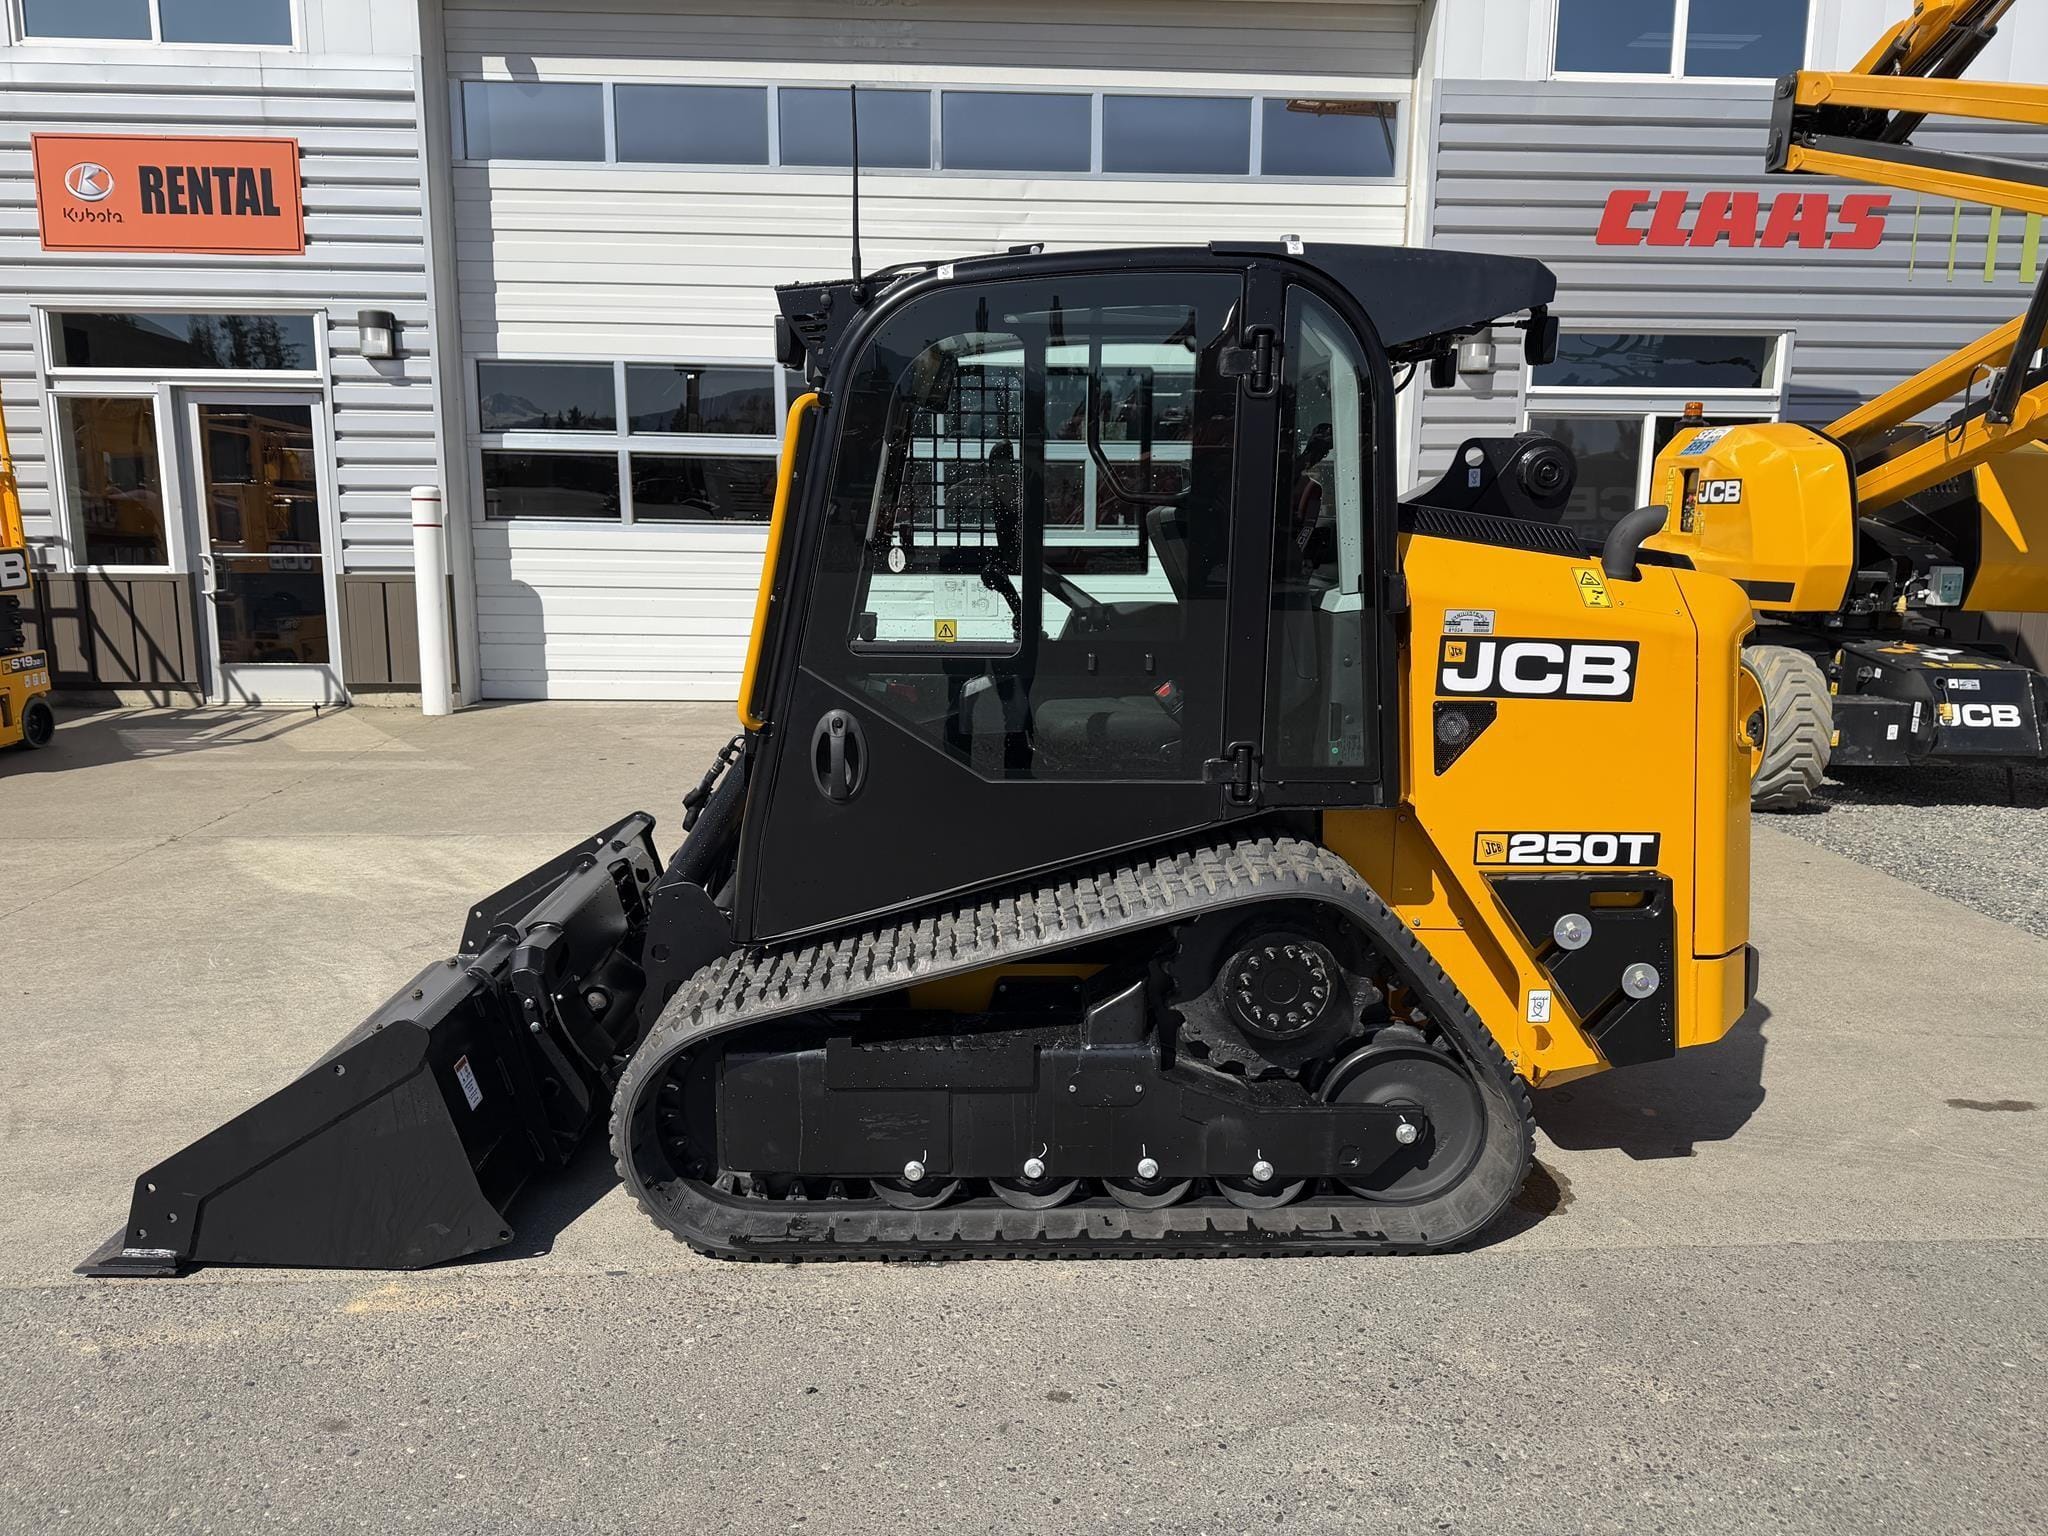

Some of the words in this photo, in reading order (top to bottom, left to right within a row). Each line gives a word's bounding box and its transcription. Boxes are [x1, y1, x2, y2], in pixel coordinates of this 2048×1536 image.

[138, 165, 281, 217] RENTAL
[63, 207, 123, 223] Kubota
[1595, 189, 1892, 249] CLAAS
[1698, 480, 1741, 503] JCB
[1442, 641, 1632, 696] JCB
[1939, 703, 2021, 727] JCB
[1485, 841, 1502, 855] JCB
[1508, 833, 1655, 865] 250T
